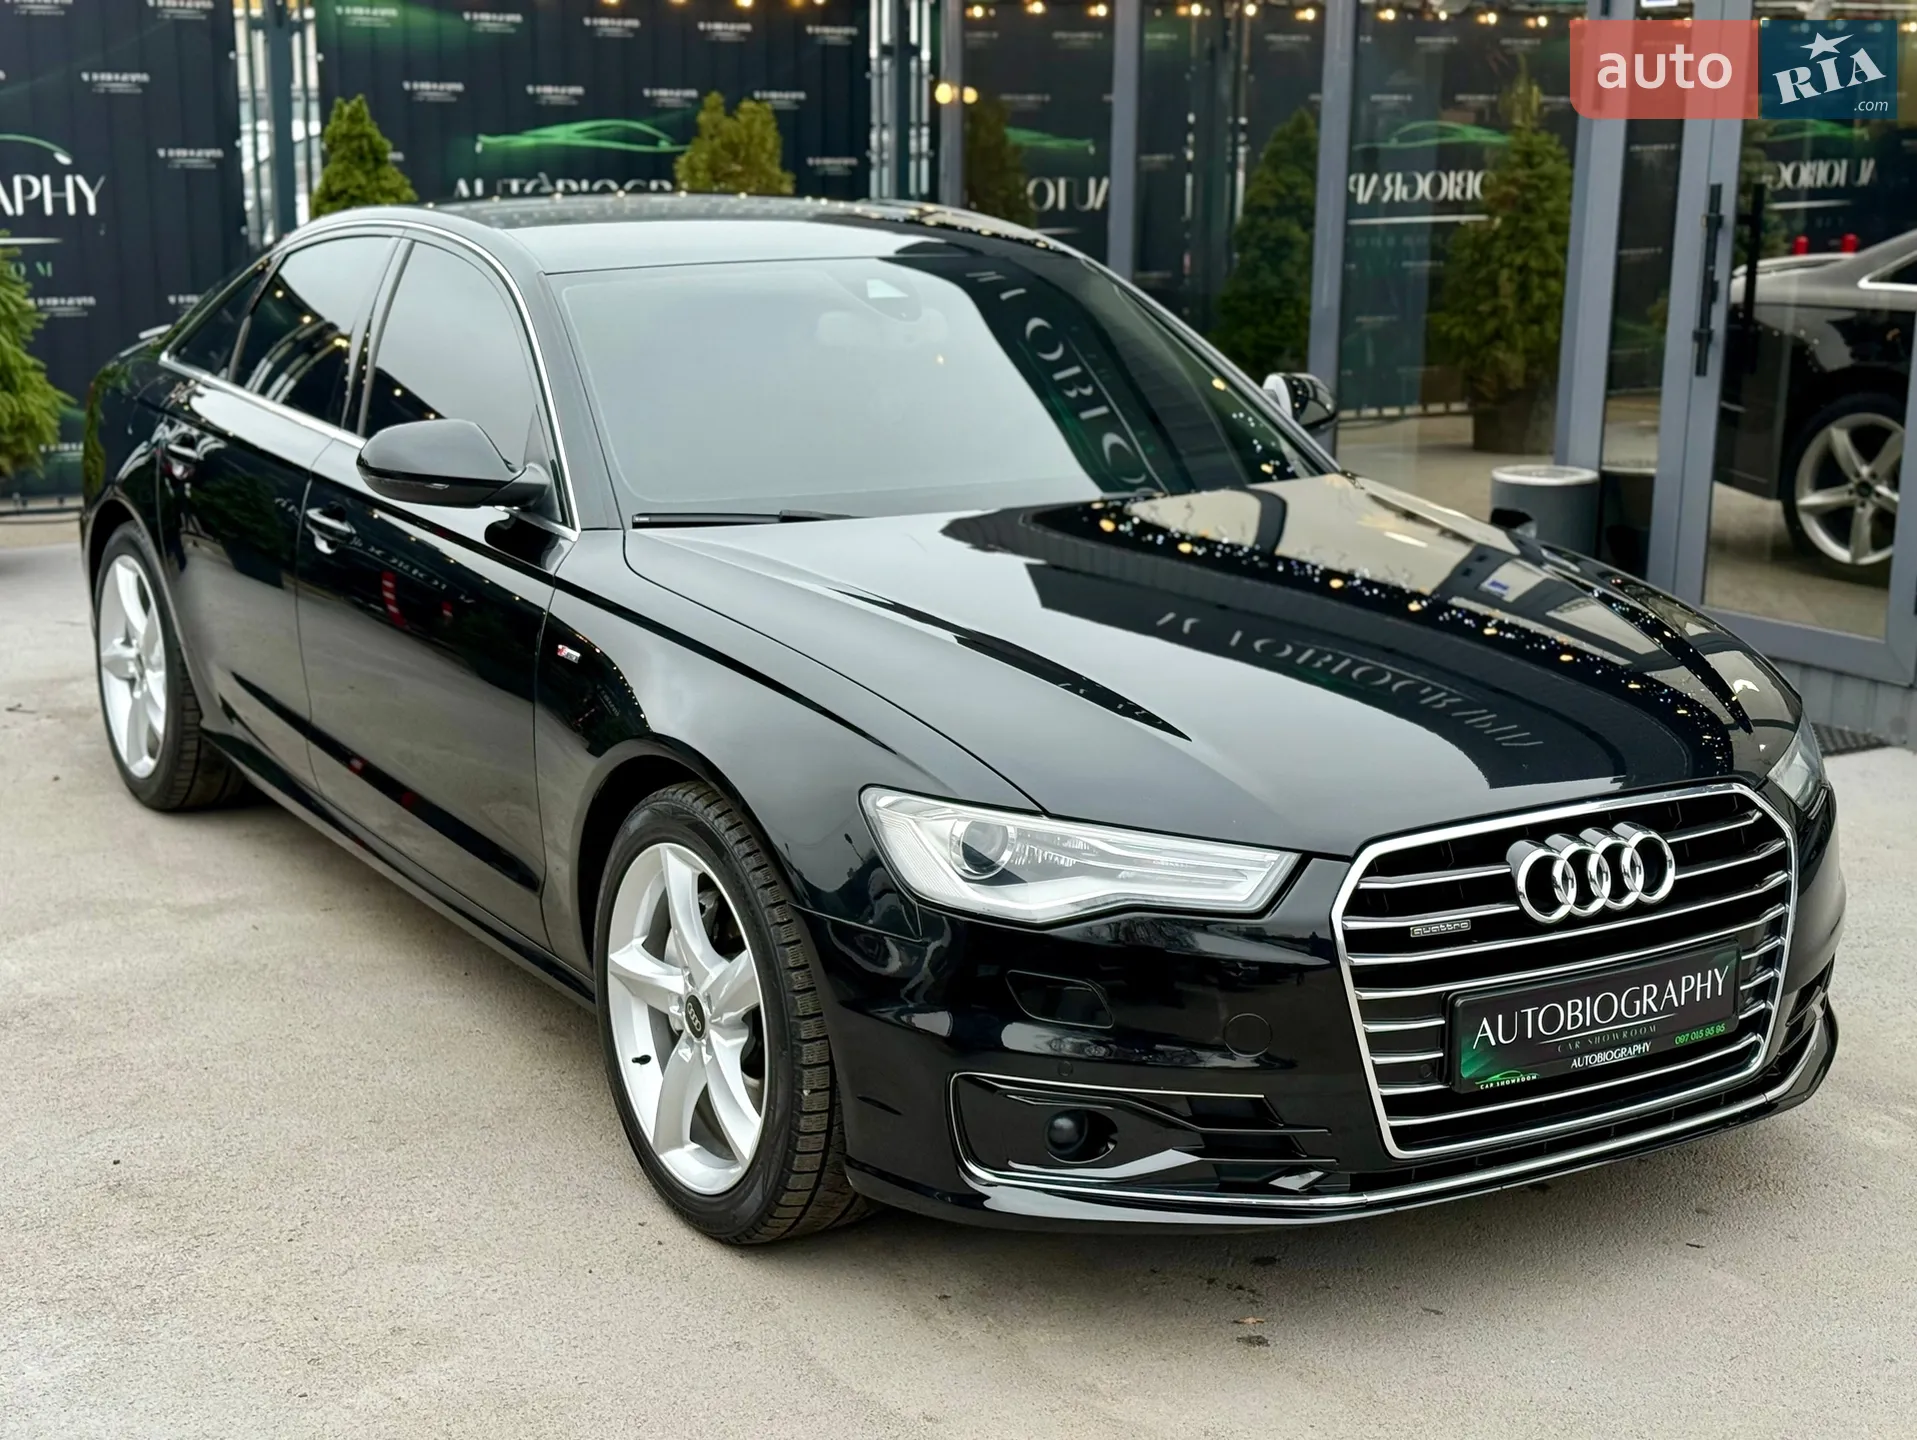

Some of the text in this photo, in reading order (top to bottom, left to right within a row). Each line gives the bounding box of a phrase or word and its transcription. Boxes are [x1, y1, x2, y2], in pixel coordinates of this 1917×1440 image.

[1412, 921, 1470, 936] quattro
[1472, 965, 1729, 1050] AUTOBIOGRAPHY
[1674, 1033, 1690, 1045] 097
[1690, 1029, 1704, 1041] 015
[1570, 1041, 1652, 1069] AUTOBIOGRAPHY
[1480, 1075, 1537, 1090] CAR SHOWROOM
